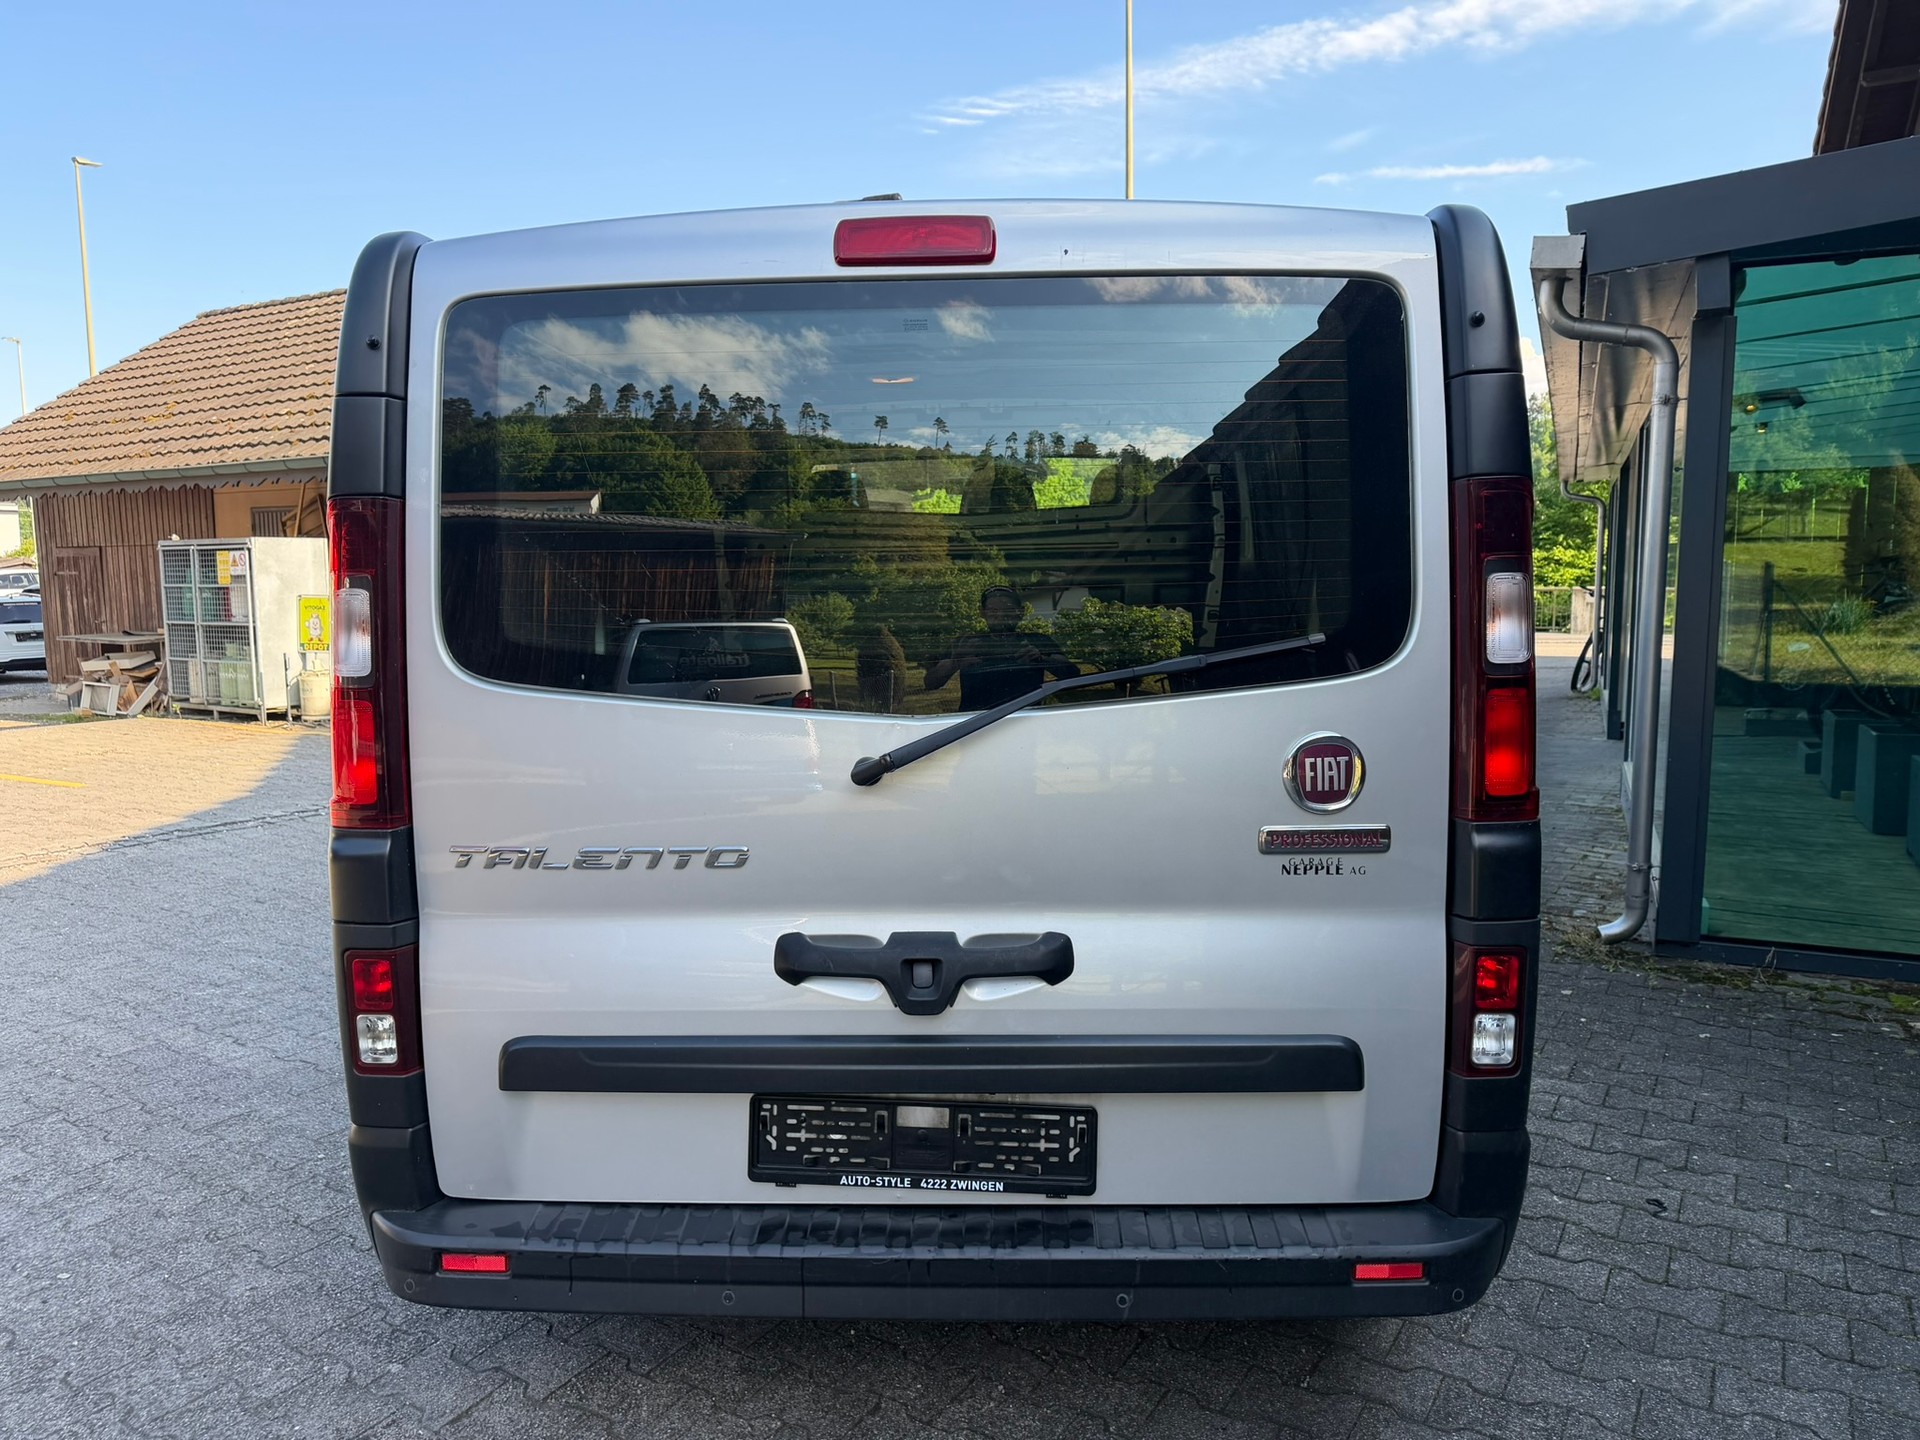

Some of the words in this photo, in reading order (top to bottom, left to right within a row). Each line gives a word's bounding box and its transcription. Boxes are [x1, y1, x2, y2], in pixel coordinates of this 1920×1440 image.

[1304, 756, 1349, 792] FIAT
[1270, 832, 1384, 848] PROFESSIONAL
[449, 845, 750, 870] TALENTO
[1288, 857, 1344, 866] GARAGE
[1281, 864, 1344, 876] NEPPLE
[1350, 865, 1366, 876] AG
[839, 1175, 912, 1188] AUTO-STYLE
[920, 1178, 947, 1189] 4222
[950, 1180, 1004, 1192] ZWINGEN
